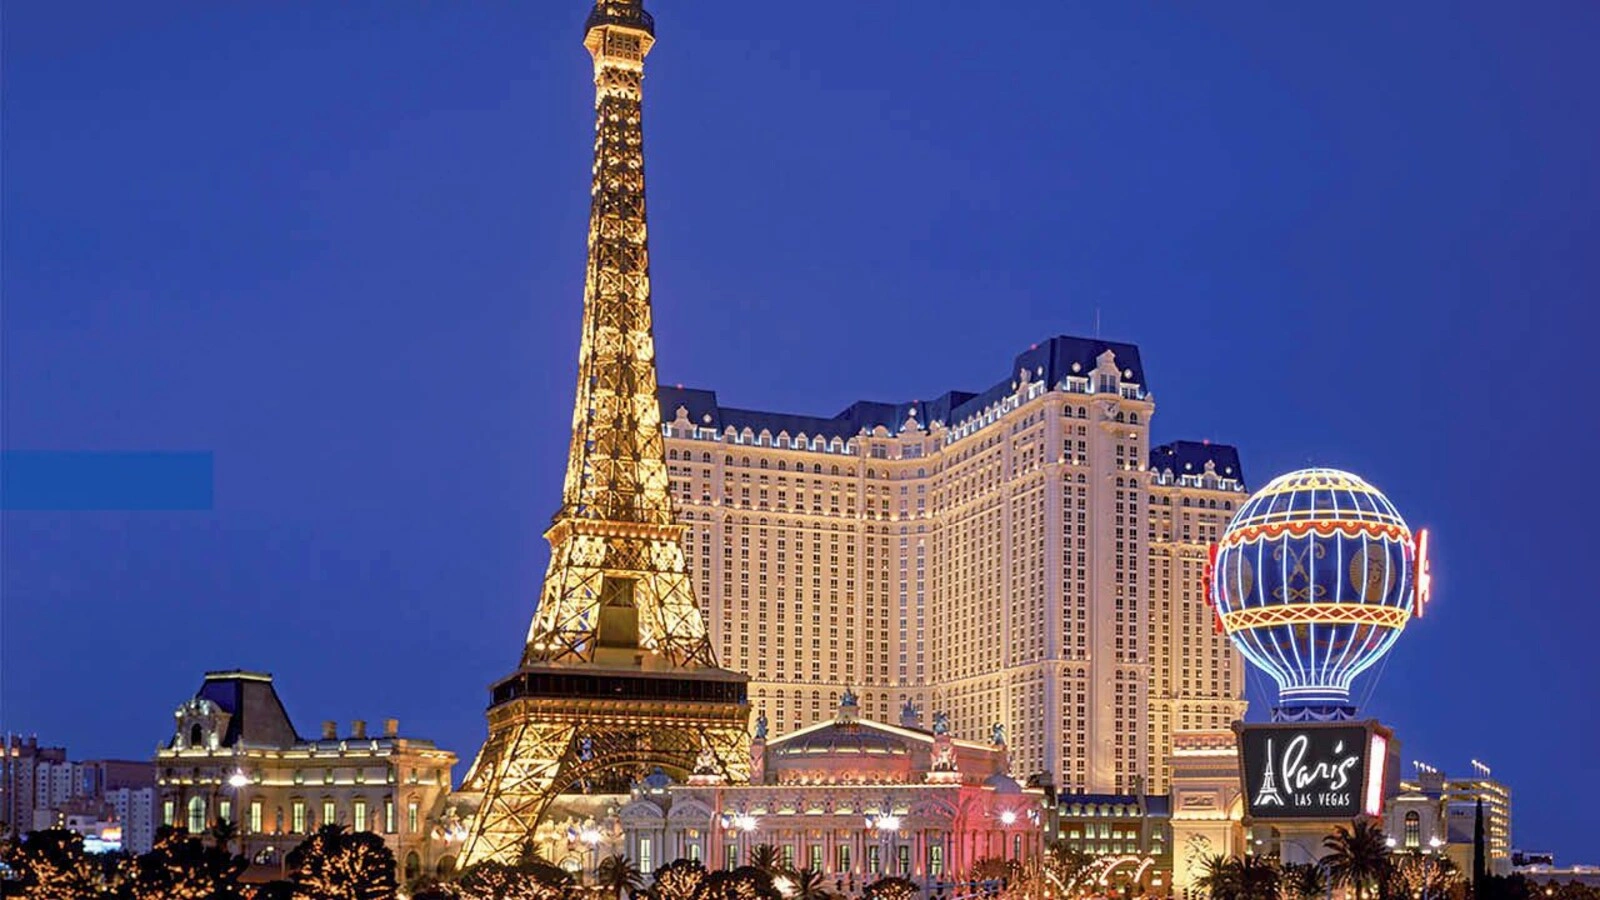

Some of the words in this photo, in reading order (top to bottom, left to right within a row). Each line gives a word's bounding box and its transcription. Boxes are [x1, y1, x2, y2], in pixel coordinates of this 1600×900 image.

[1282, 735, 1359, 794] Paris
[1295, 793, 1312, 806] LAS
[1319, 793, 1350, 806] VEGAS
